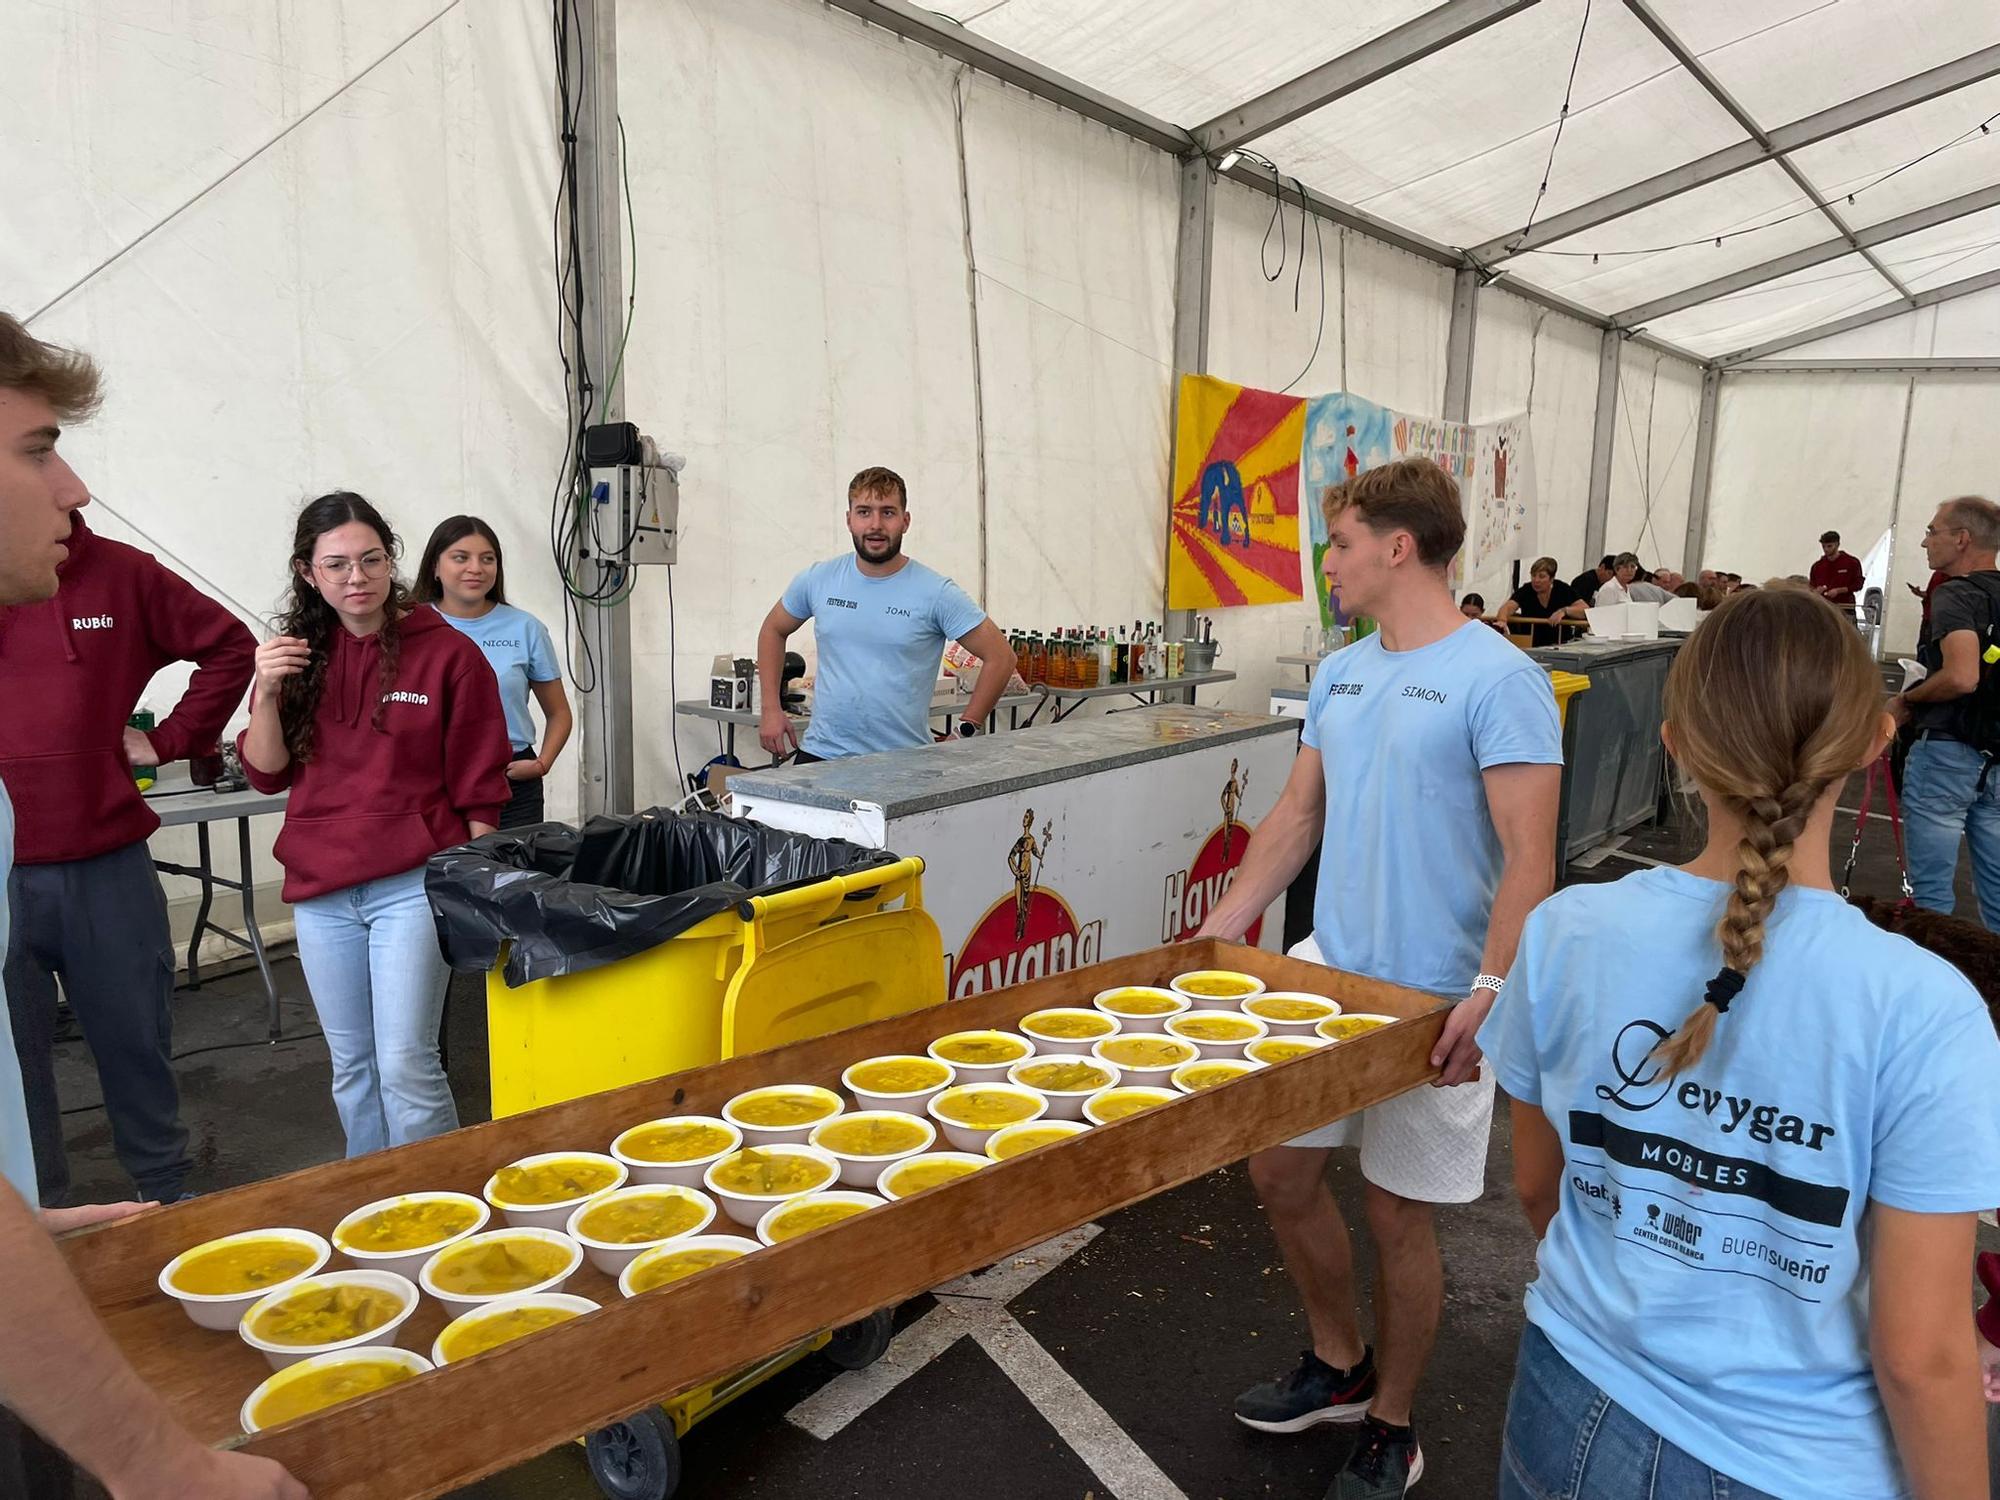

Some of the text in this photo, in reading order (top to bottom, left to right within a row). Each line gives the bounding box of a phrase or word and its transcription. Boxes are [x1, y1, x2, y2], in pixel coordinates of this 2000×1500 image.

[72, 614, 114, 630] RUBÉN
[885, 606, 911, 617] JOAN
[482, 639, 521, 648] NICOLE
[1401, 686, 1447, 704] SIMON
[944, 919, 1102, 1001] avana
[1595, 1019, 1835, 1151] Devygar
[1640, 1142, 1749, 1186] MOBLES
[1633, 1226, 1705, 1262] CENTER COSTA BLANCA
[1662, 1211, 1702, 1246] weber
